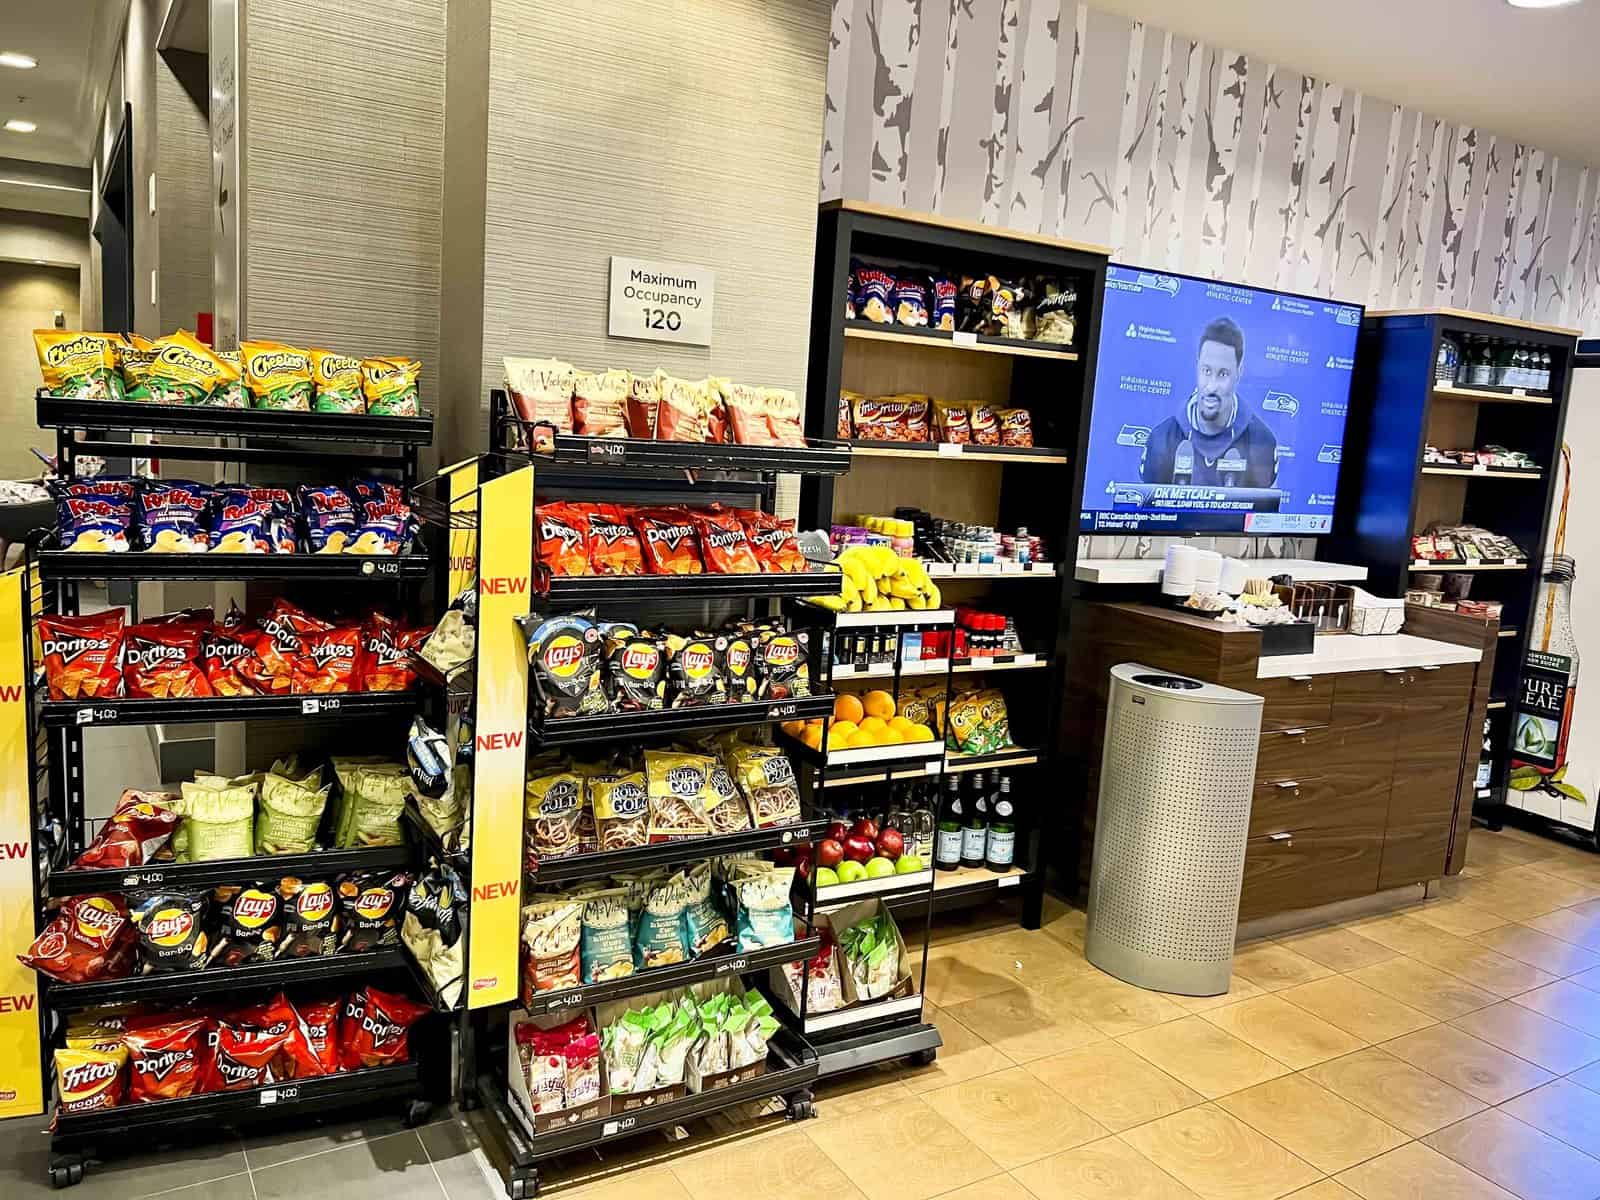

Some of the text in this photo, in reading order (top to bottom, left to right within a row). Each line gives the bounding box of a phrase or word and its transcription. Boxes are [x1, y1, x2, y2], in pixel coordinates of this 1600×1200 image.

[630, 269, 697, 290] Maximum
[623, 286, 702, 309] Occupancy
[642, 308, 682, 331] 120
[48, 337, 104, 366] Cheetos
[252, 352, 304, 378] Cheetos
[321, 355, 362, 379] Cheeto
[1154, 486, 1216, 500] DK METCALF
[480, 577, 527, 595] NEW
[44, 638, 110, 656] Doritos
[1523, 677, 1563, 699] URE
[319, 699, 340, 711] 4.00
[1521, 690, 1560, 711] EAF
[94, 708, 118, 719] 4.00
[476, 731, 523, 751] NEW
[142, 873, 164, 883] 4.00
[472, 879, 518, 902] NEW
[0, 994, 33, 1013] EW
[63, 1062, 117, 1091] Fritos
[277, 1088, 298, 1099] 4.00
